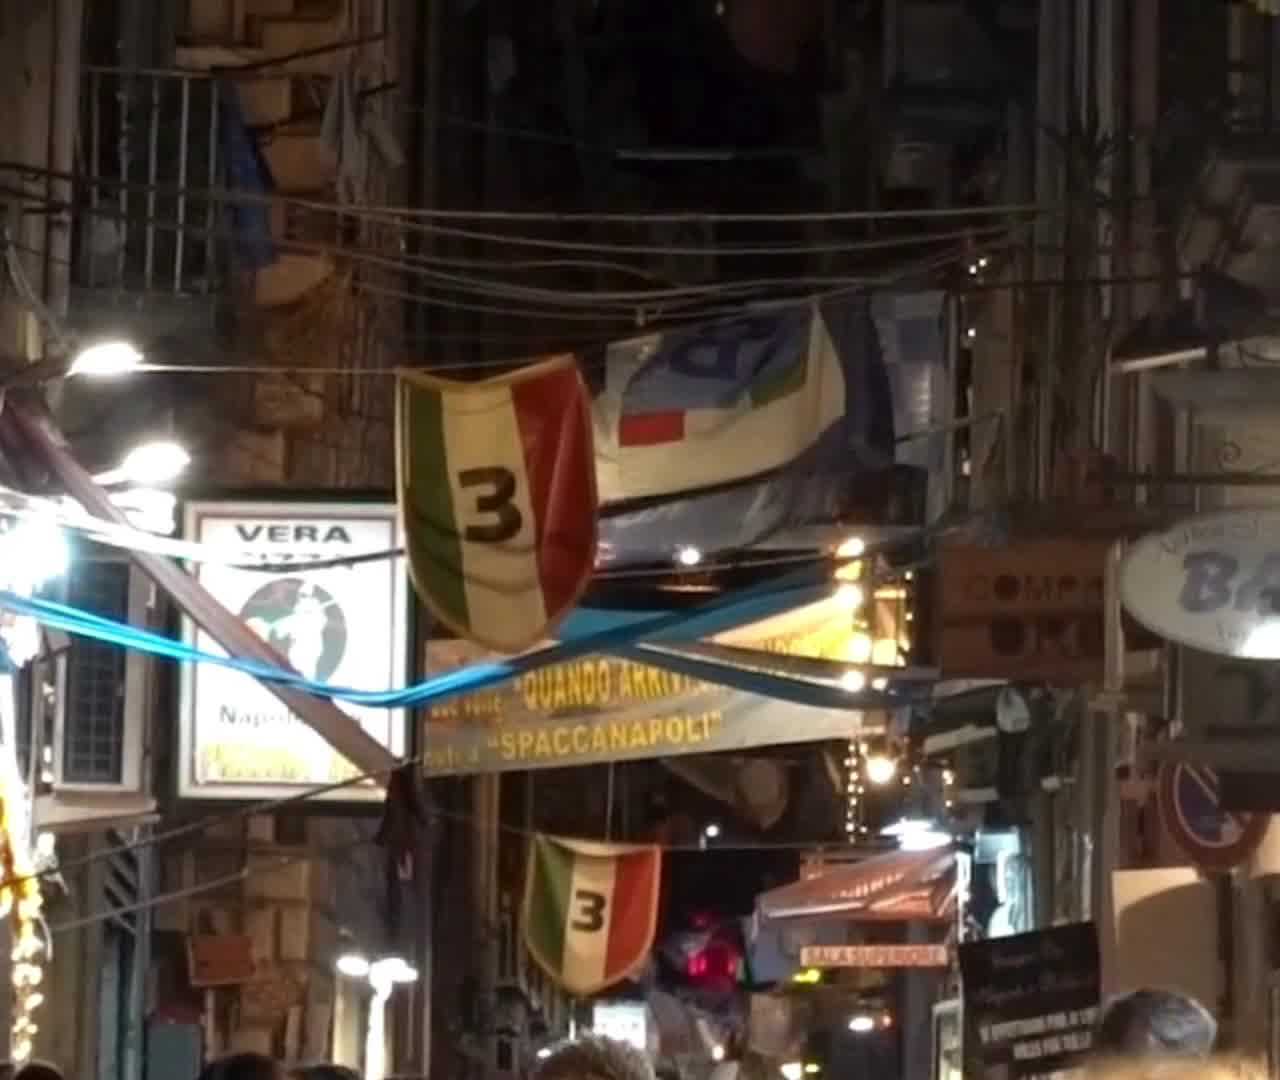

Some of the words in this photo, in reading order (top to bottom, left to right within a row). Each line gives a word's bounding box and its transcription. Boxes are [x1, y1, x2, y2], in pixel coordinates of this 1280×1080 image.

[457, 466, 523, 543] 3
[235, 524, 352, 544] VERA
[571, 889, 607, 932] 3
